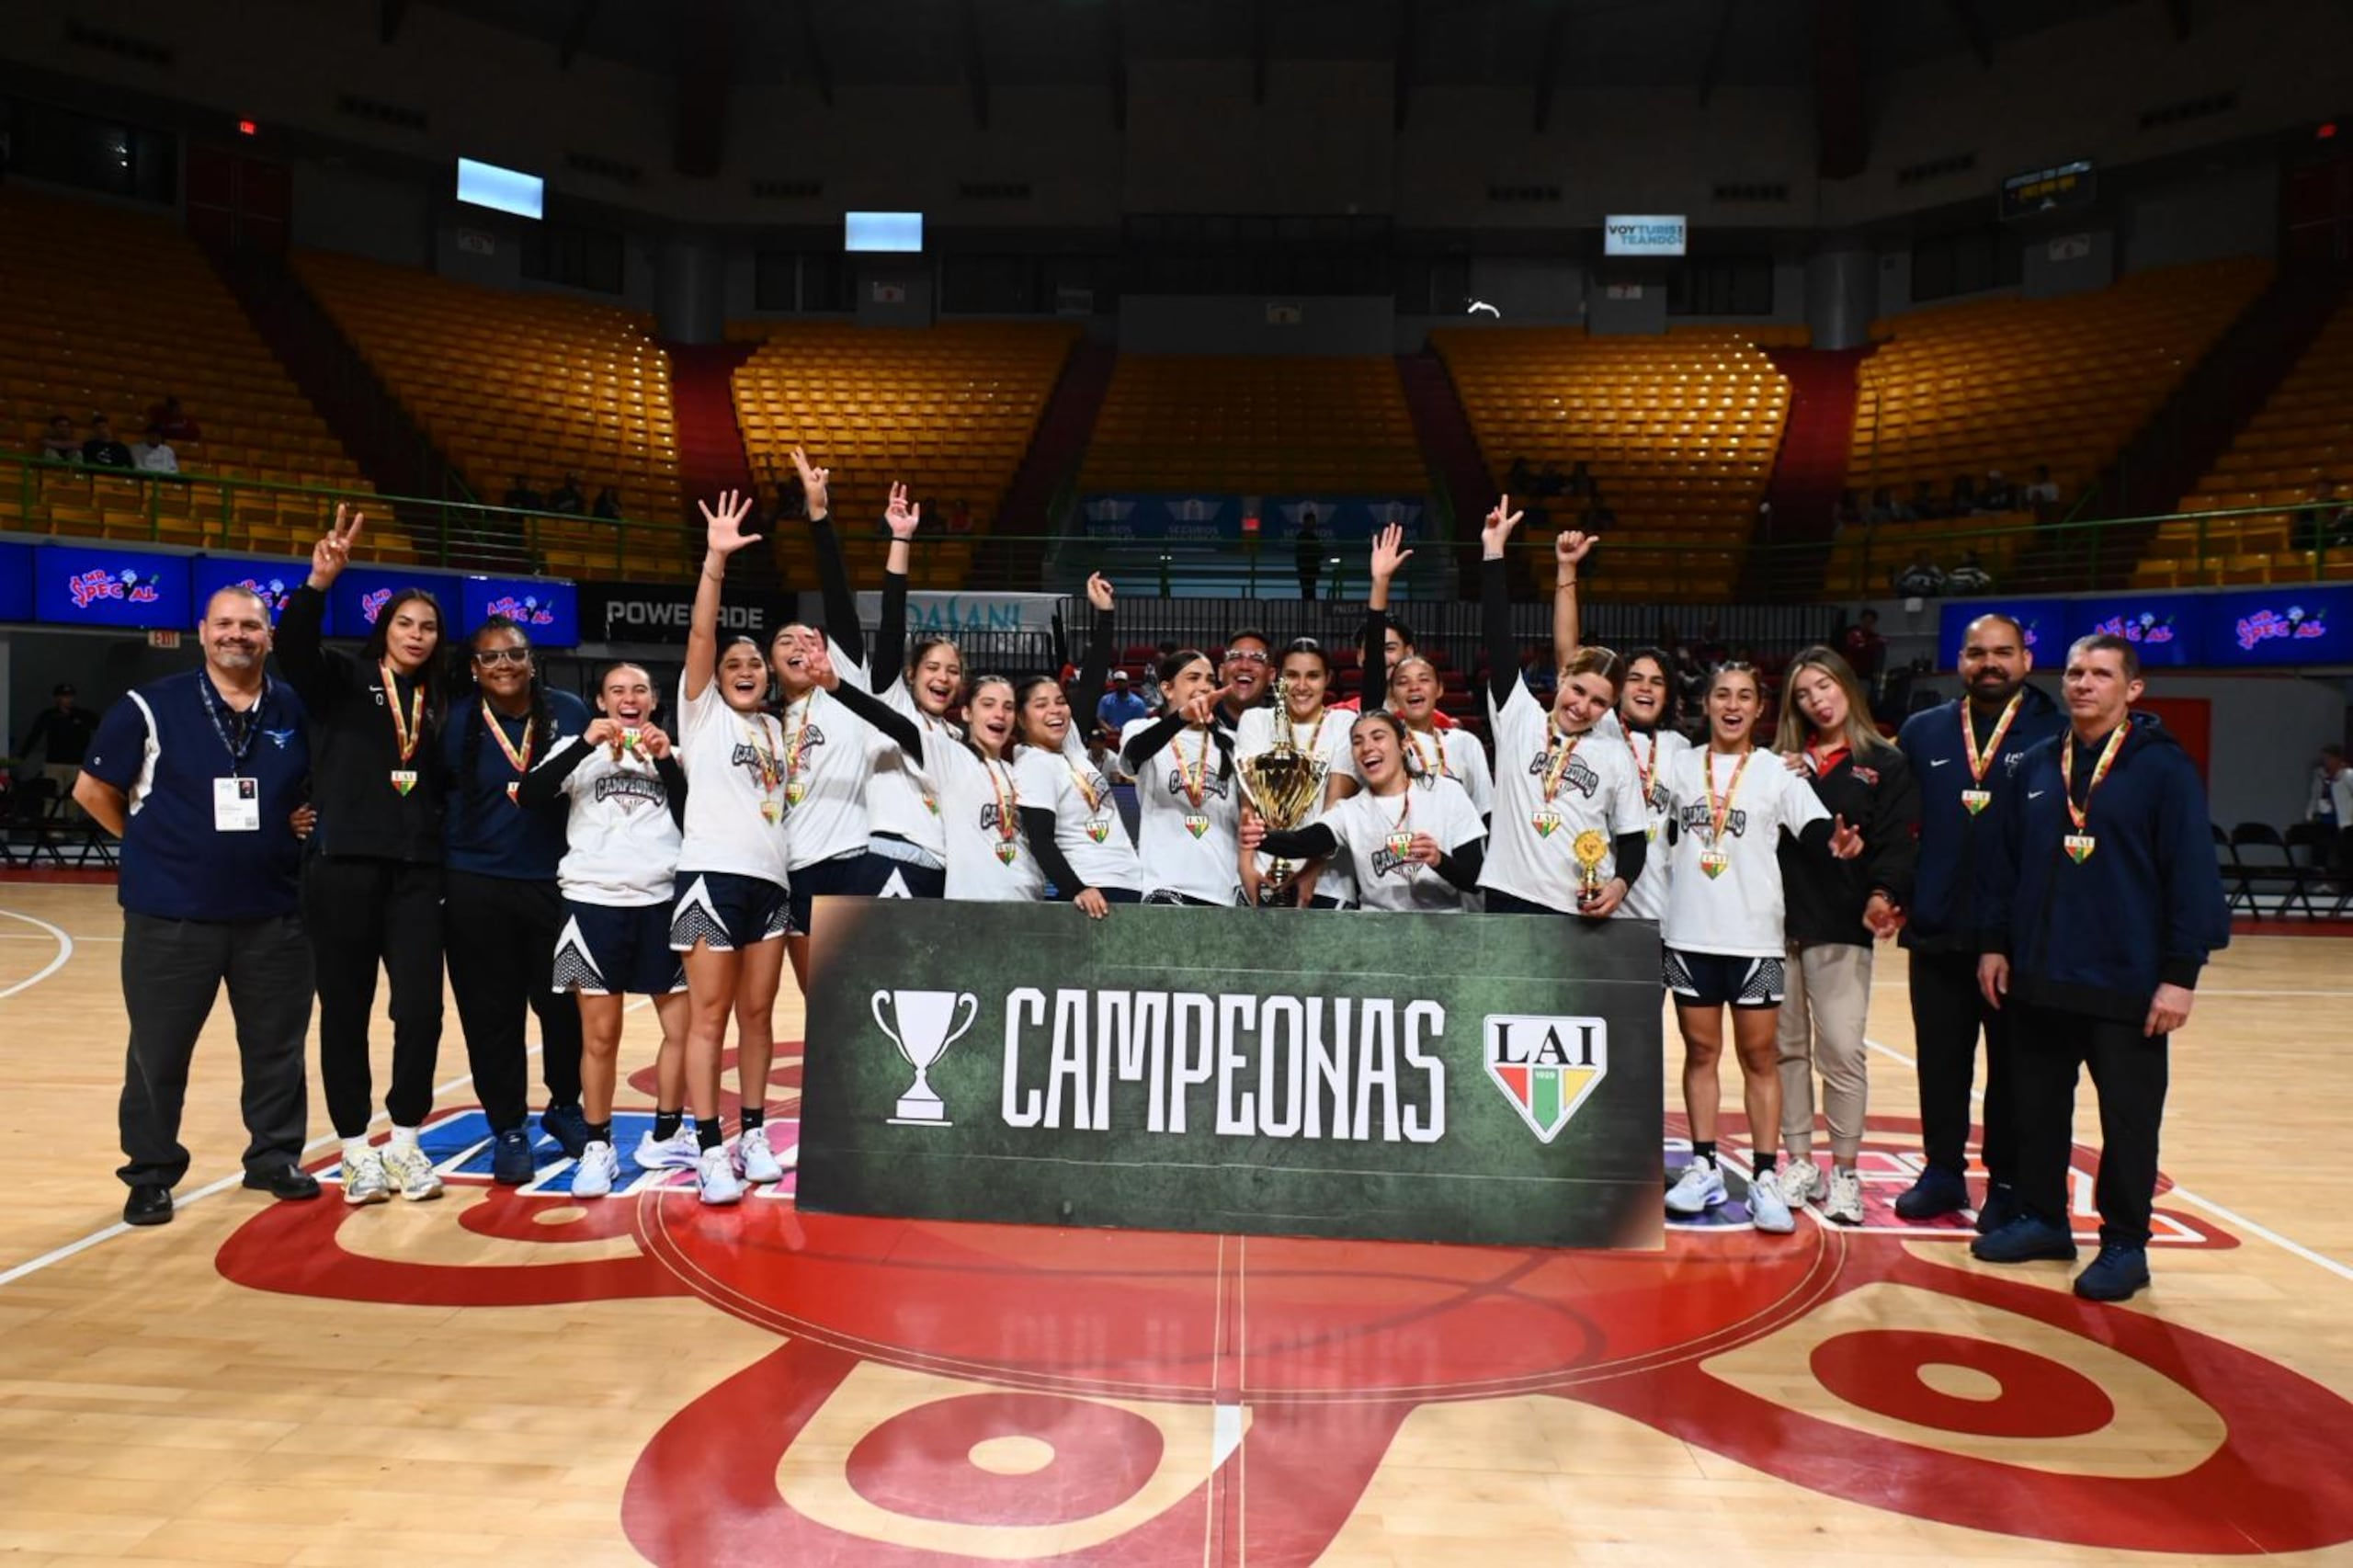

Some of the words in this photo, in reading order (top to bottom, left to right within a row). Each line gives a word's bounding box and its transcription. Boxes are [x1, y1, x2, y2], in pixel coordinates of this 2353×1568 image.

[607, 601, 764, 630] POWEADE
[1002, 987, 1446, 1142] CAMPEONAS
[1494, 1023, 1597, 1066] LAI
